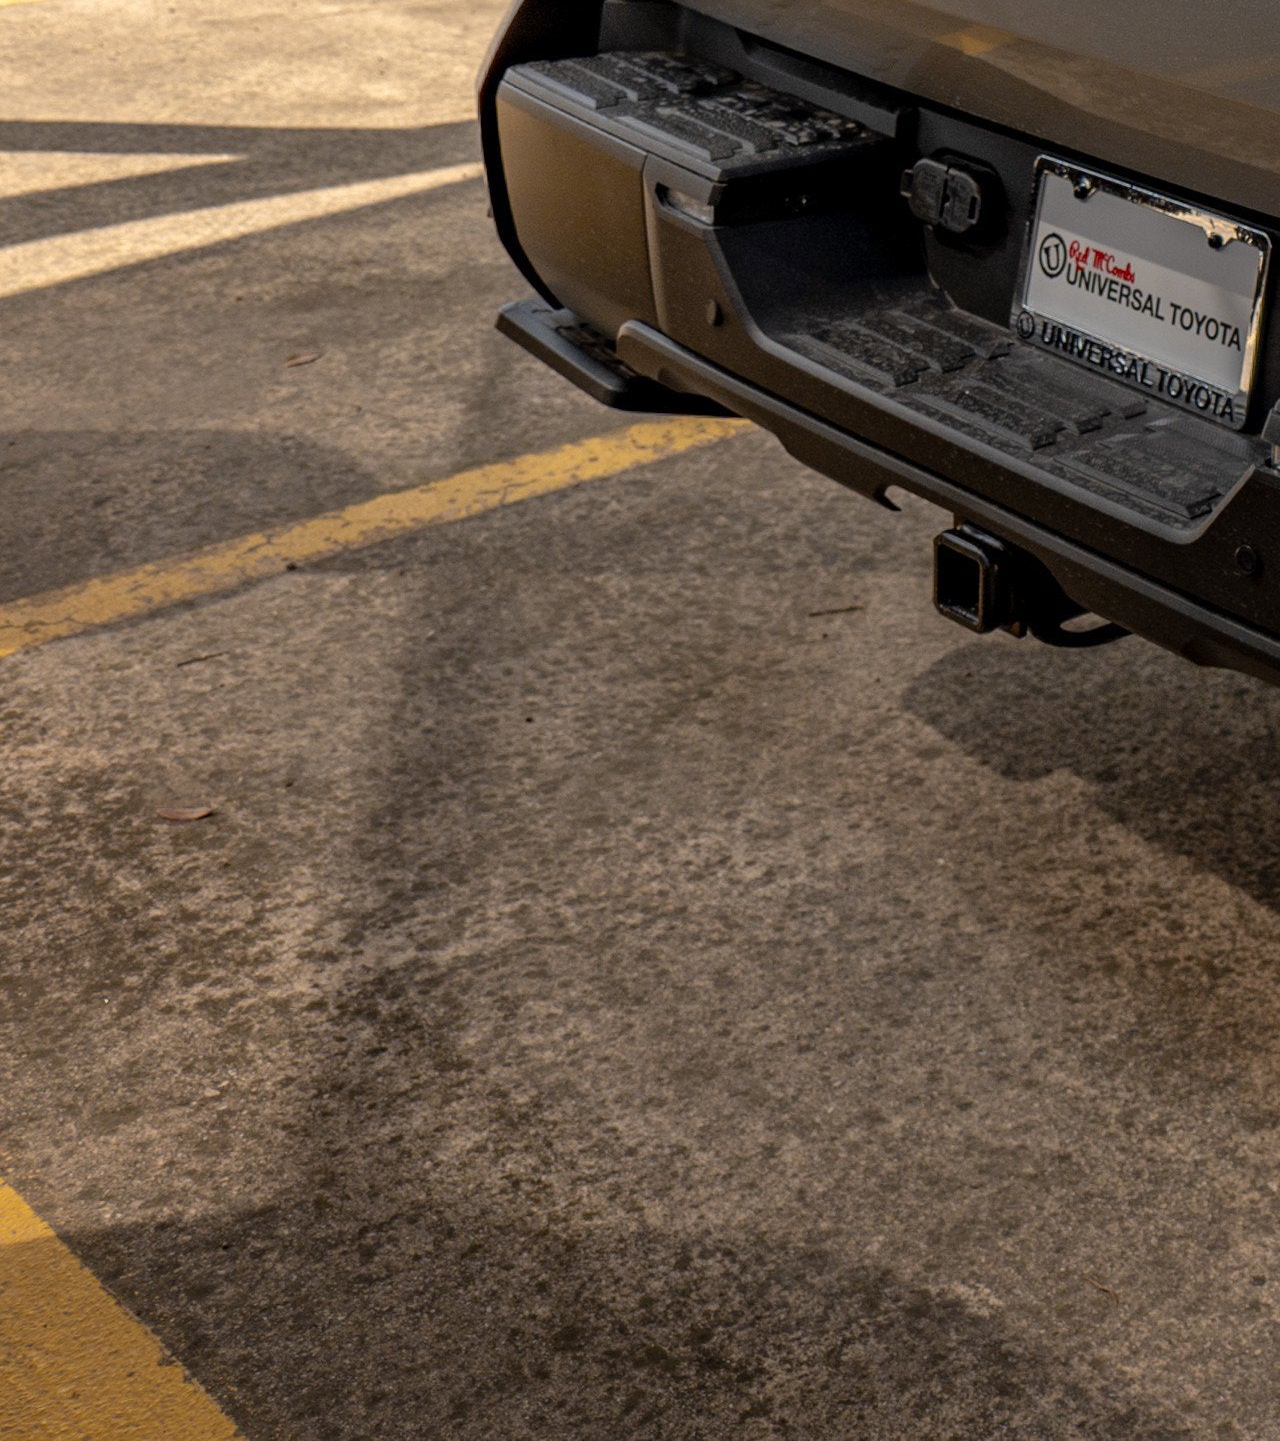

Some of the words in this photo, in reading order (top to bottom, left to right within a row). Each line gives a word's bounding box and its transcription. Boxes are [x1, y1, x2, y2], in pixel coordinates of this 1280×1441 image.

[1069, 240, 1090, 272] Red
[1066, 262, 1164, 321] UNIVERSAL
[1170, 302, 1242, 352] TOYOTA
[1041, 321, 1153, 387] UNIVERSAL
[1157, 367, 1235, 423] TOYOTA
